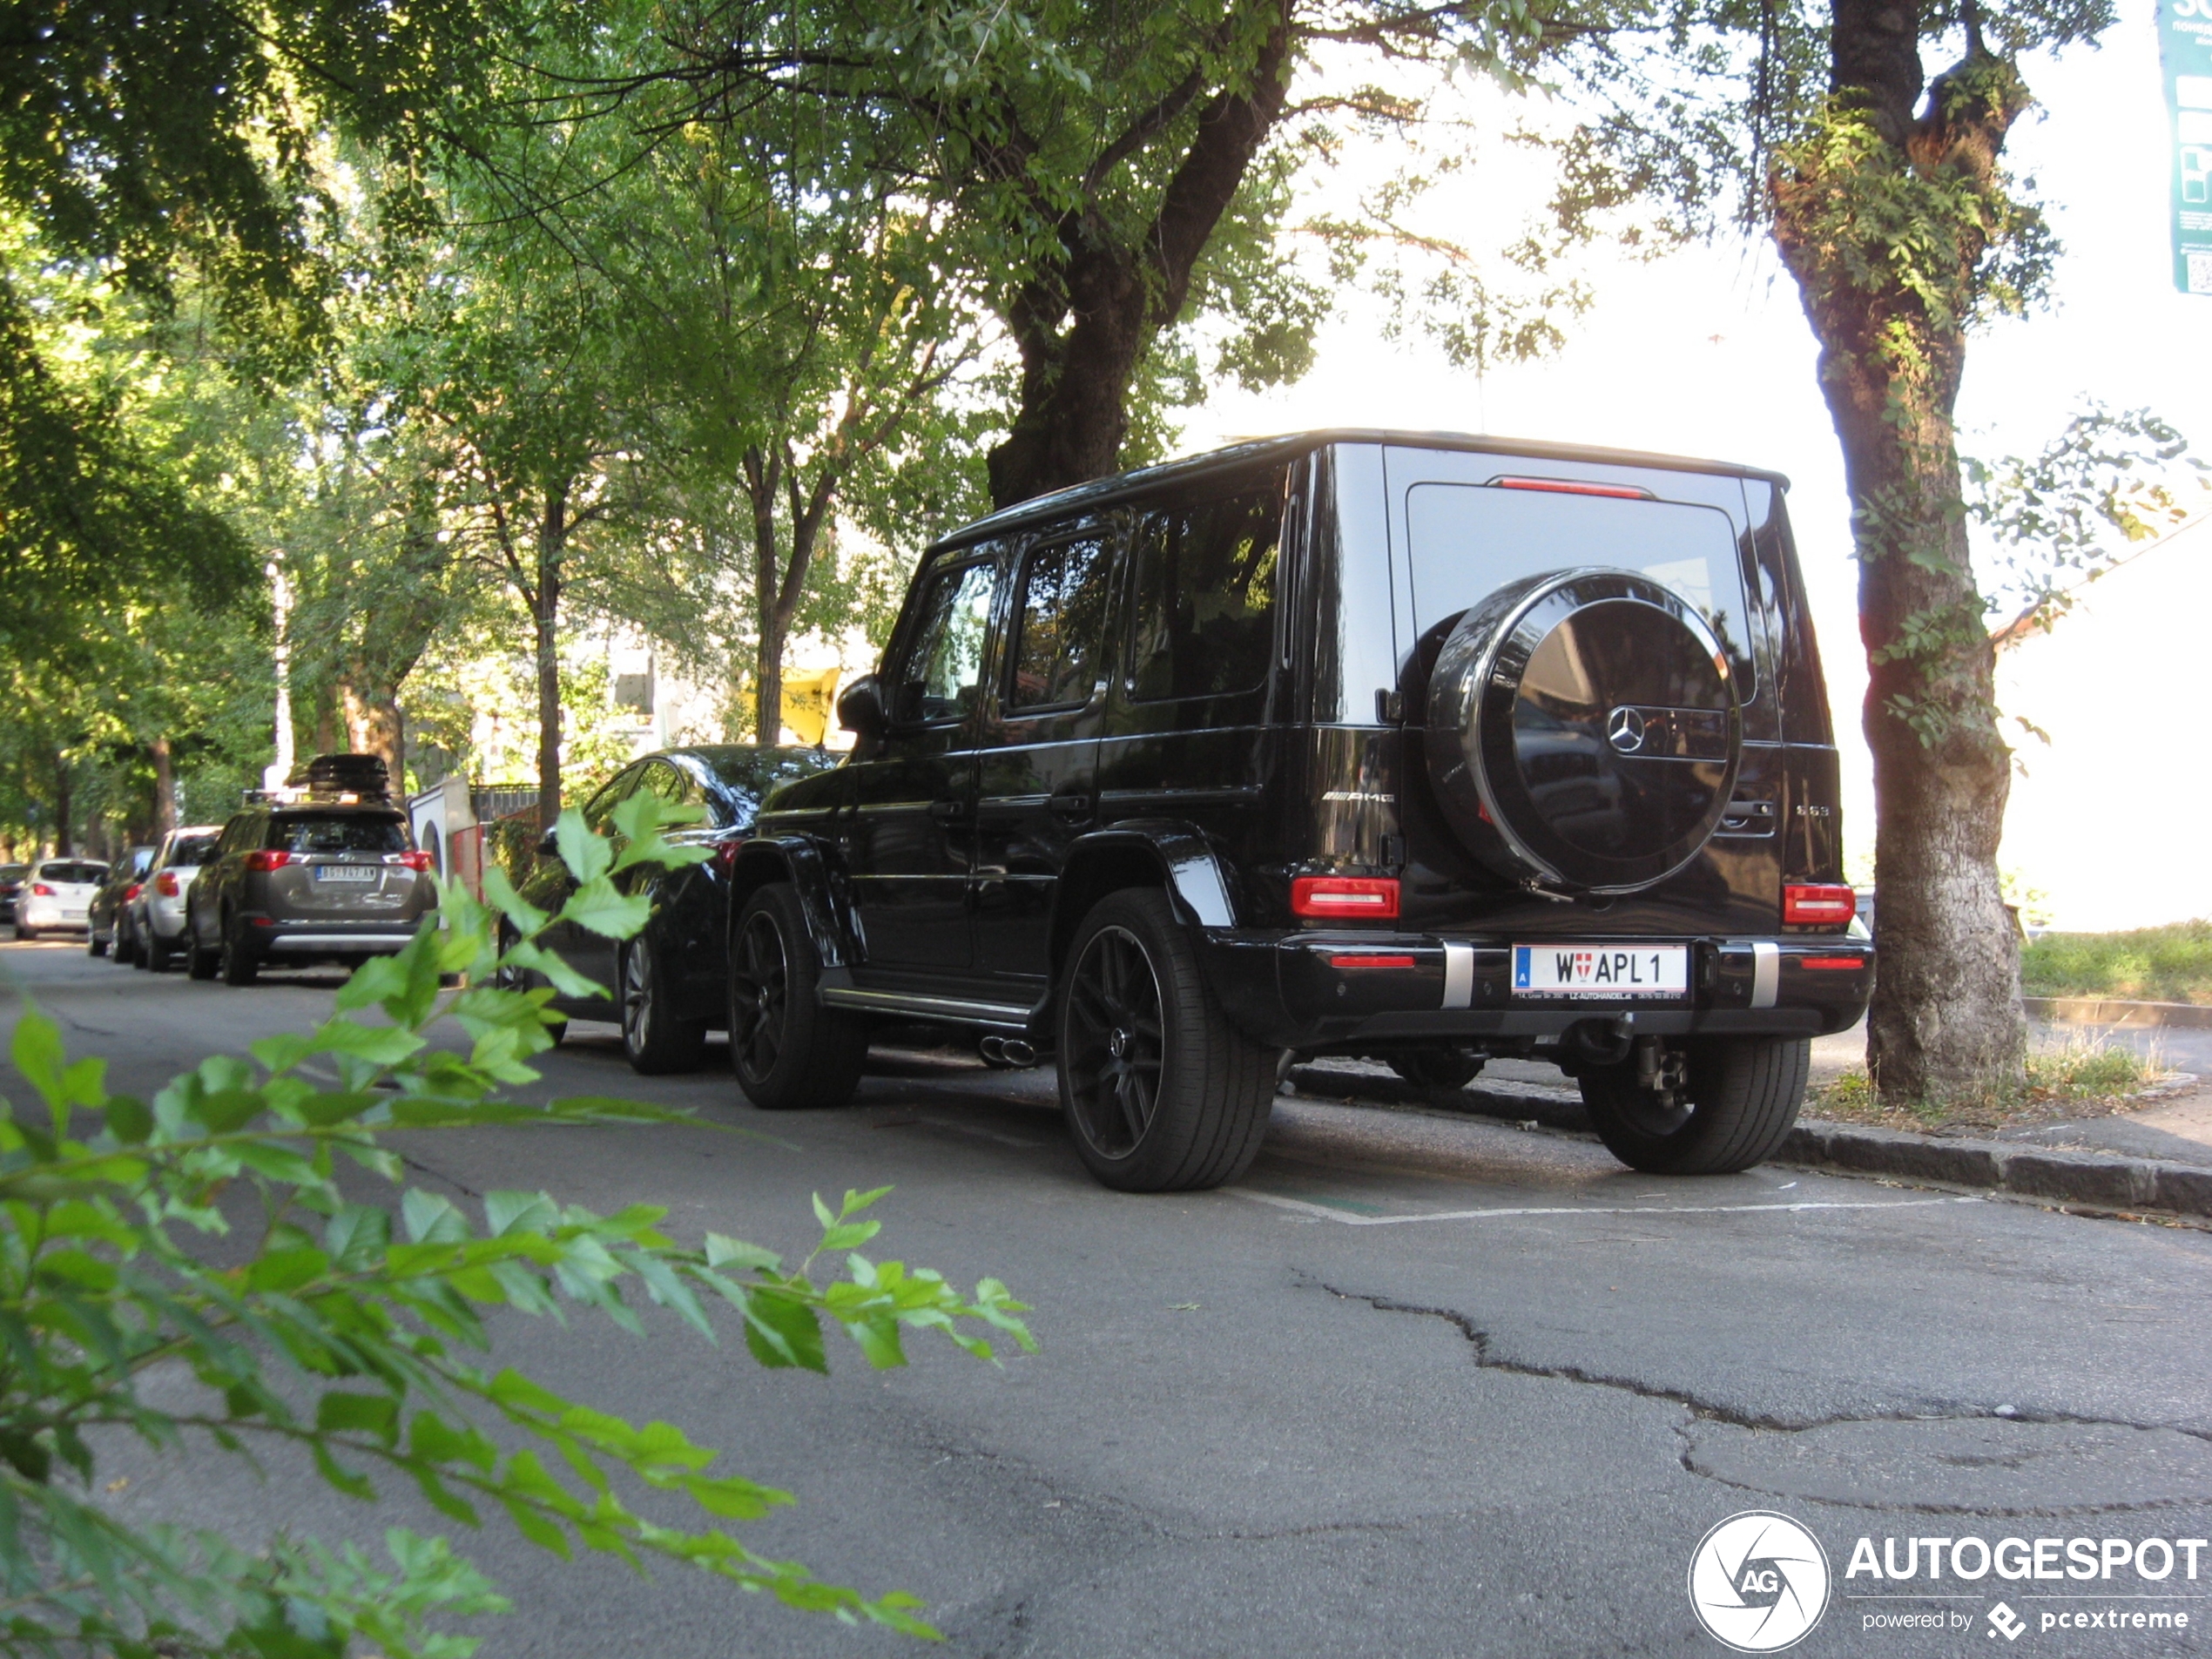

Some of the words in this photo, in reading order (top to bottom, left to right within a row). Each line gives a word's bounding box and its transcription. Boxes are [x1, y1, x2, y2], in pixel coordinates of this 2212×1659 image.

[1346, 792, 1395, 802] AMG
[1555, 953, 1575, 982] W
[1595, 953, 1642, 983] APL
[1649, 954, 1660, 983] 1
[1519, 973, 1527, 982] A
